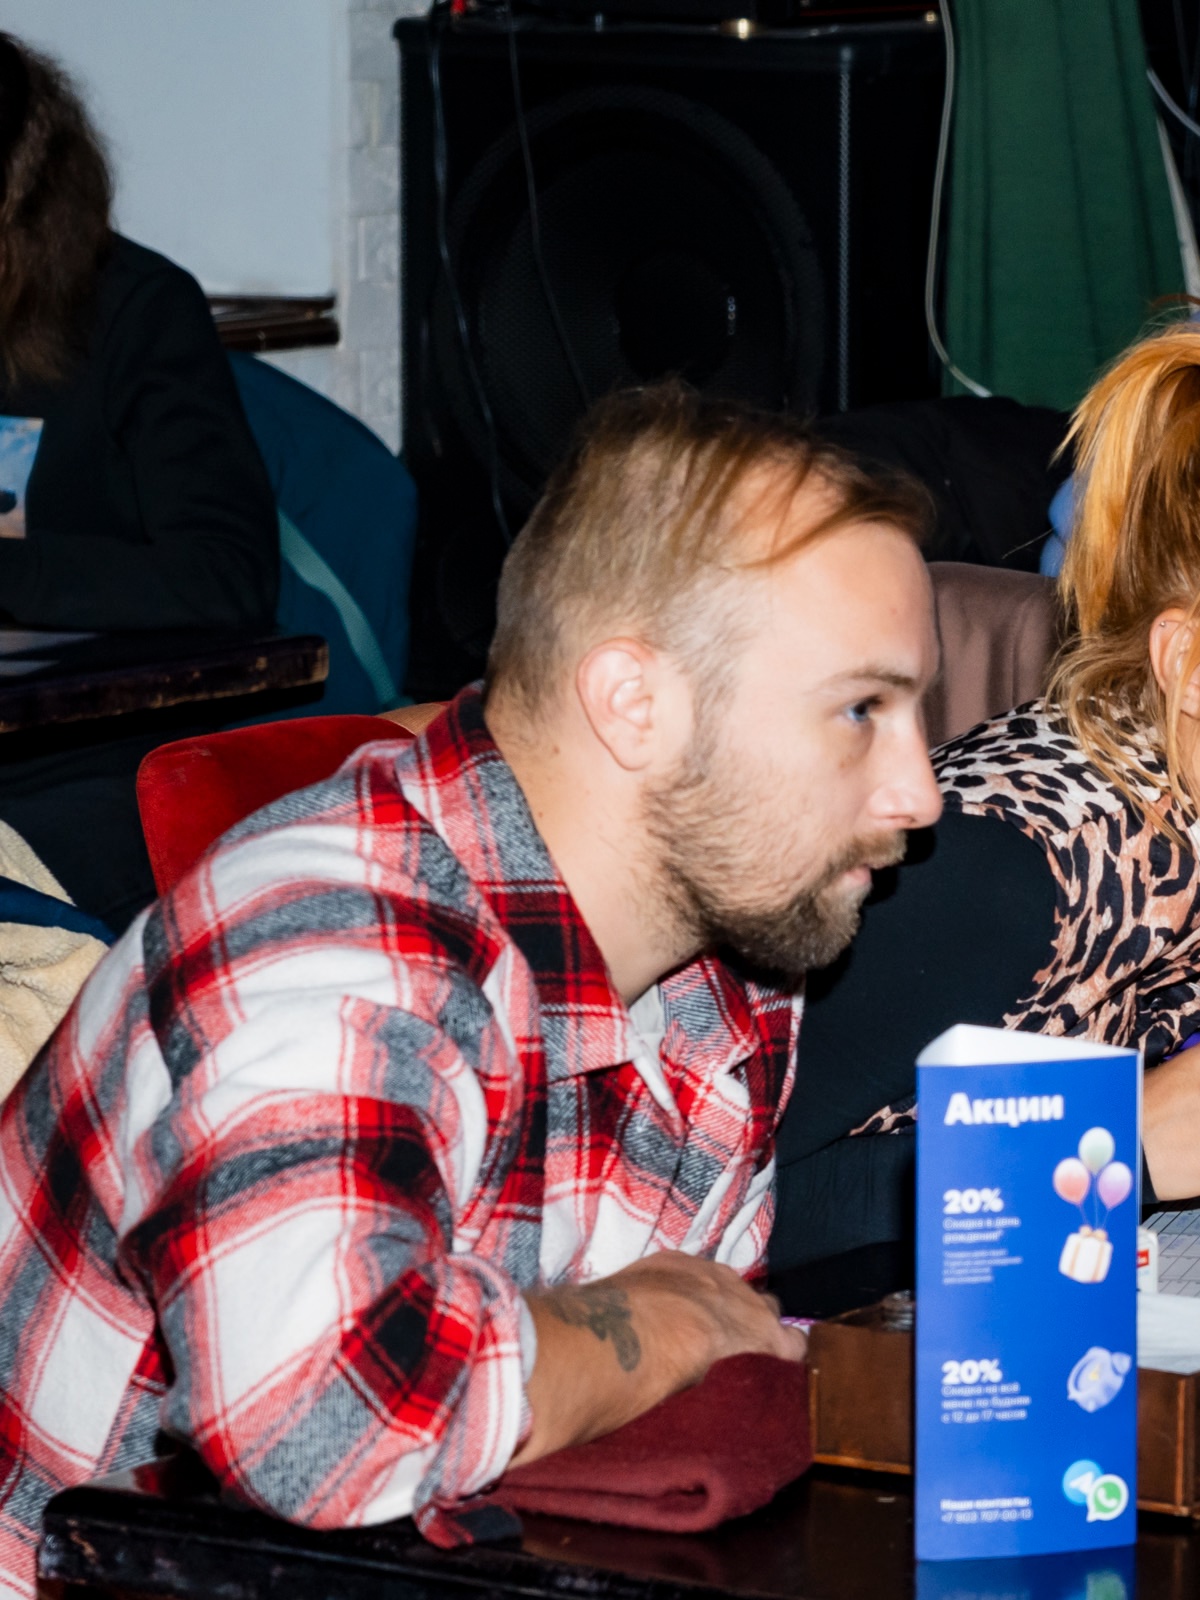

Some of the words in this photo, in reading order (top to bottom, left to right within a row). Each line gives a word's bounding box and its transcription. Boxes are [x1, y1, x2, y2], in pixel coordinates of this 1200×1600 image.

[944, 1091, 1063, 1127] Акции
[943, 1188, 1004, 1214] 20%
[943, 1218, 983, 1231] Скидка
[995, 1217, 1020, 1229] день
[941, 1359, 1003, 1385] 20%
[942, 1385, 982, 1397] Скидка
[952, 1411, 964, 1423] 12
[966, 1412, 980, 1423] до
[981, 1409, 993, 1421] 17
[995, 1409, 1027, 1420] часов
